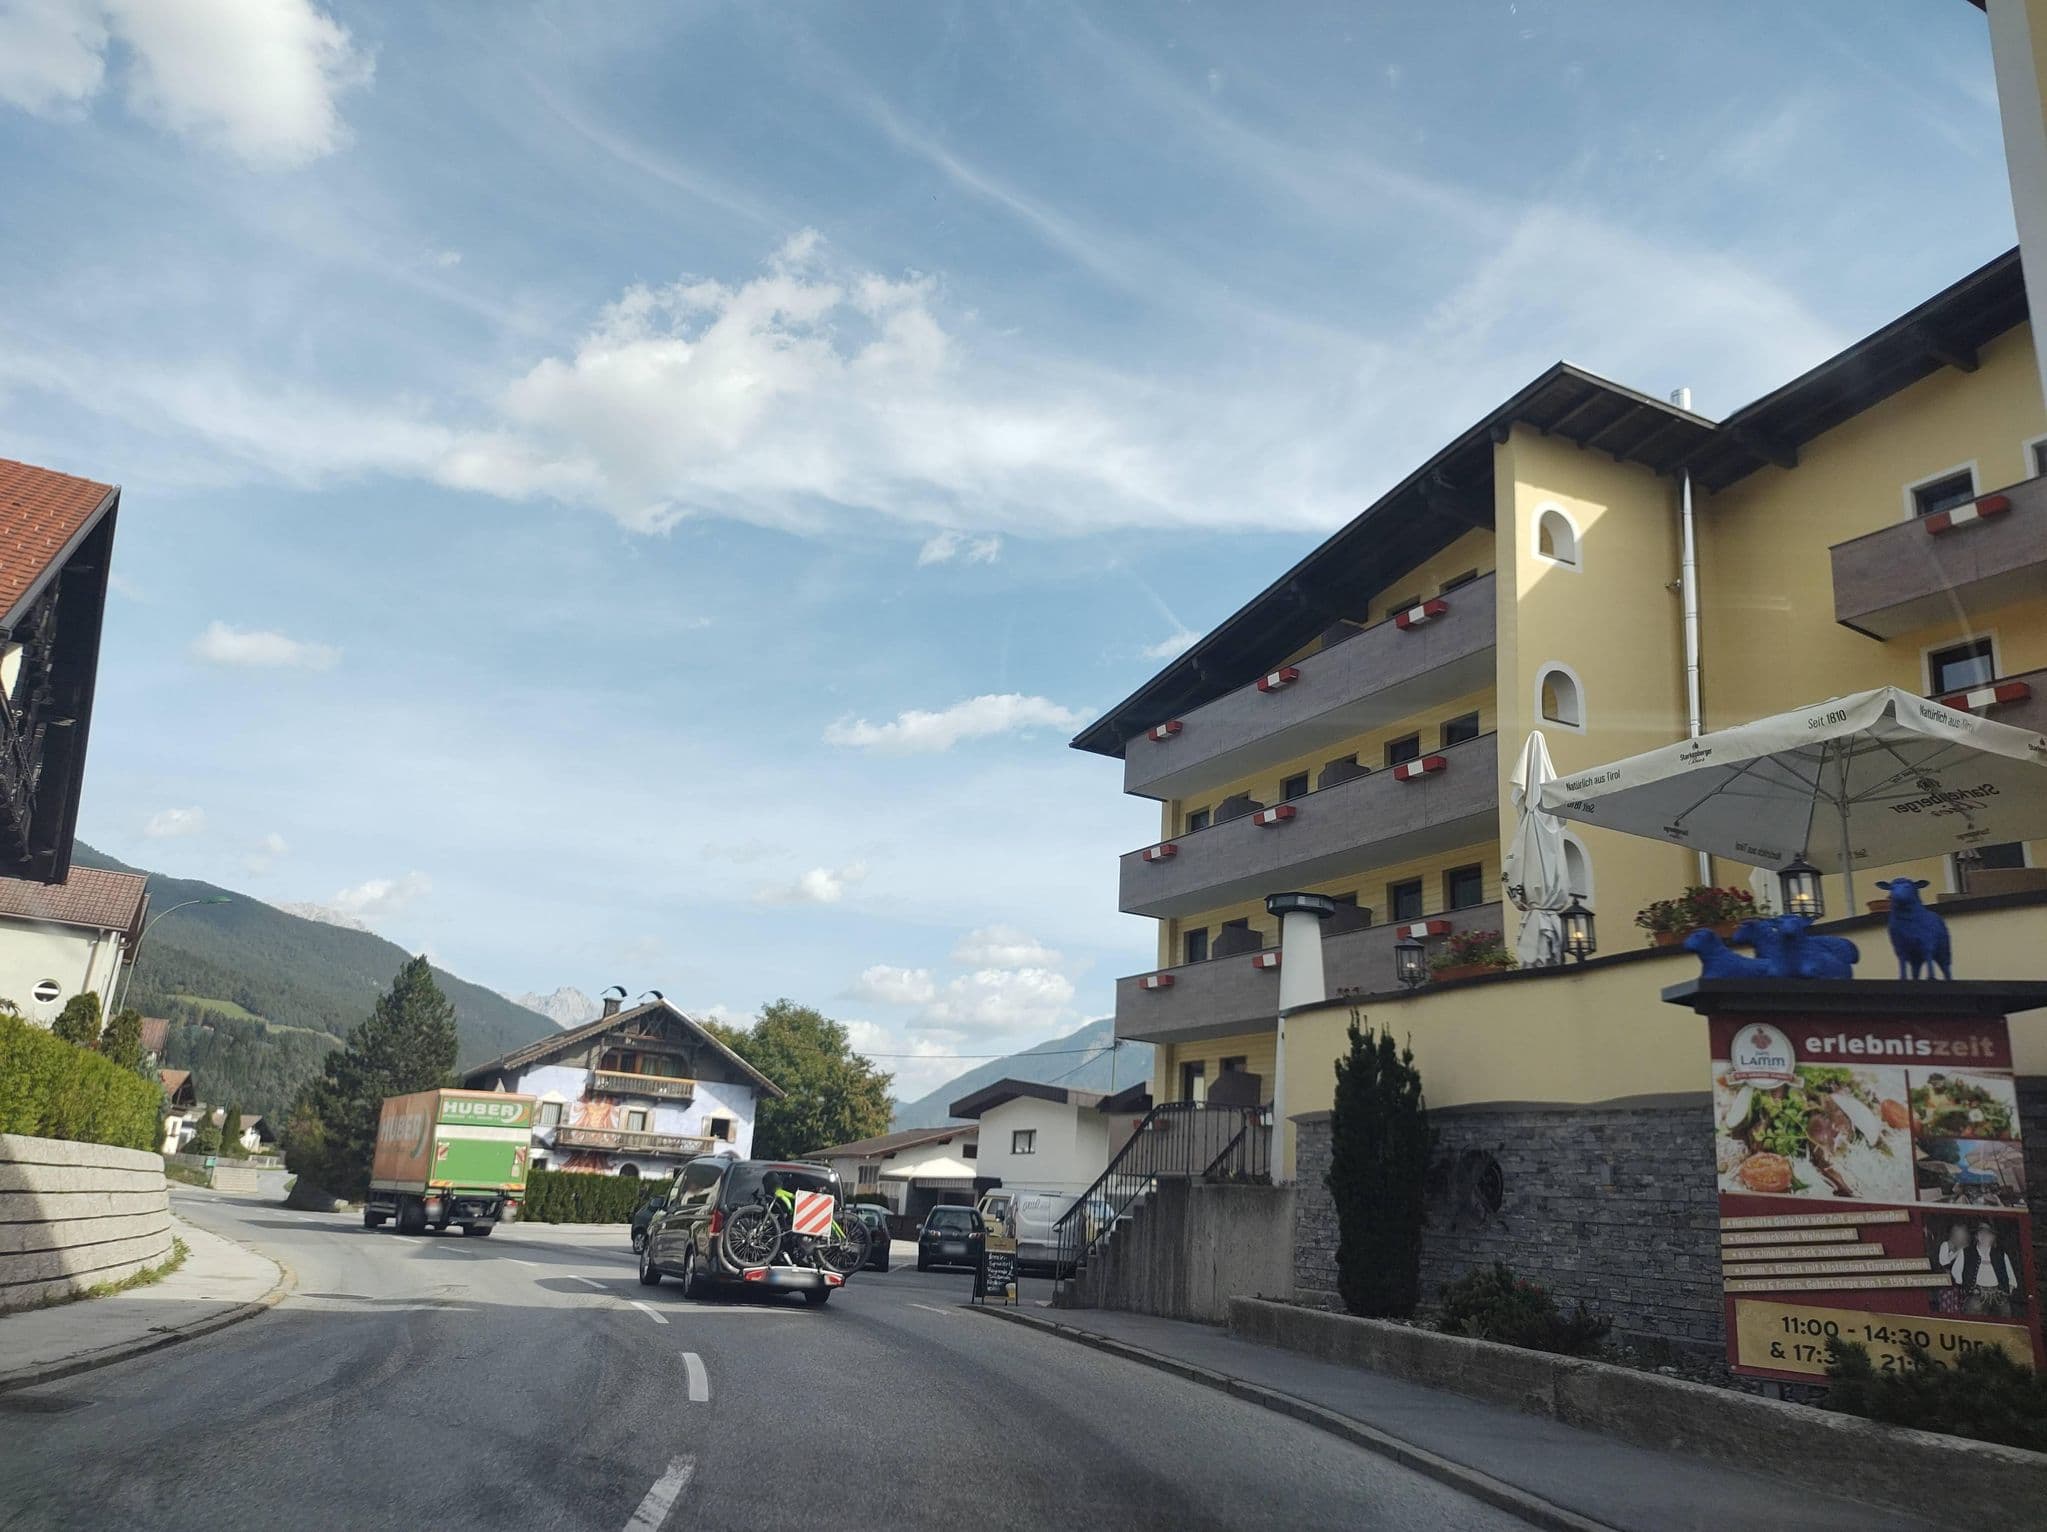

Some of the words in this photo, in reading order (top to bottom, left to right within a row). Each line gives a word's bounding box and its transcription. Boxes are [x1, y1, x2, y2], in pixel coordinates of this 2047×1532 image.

[1807, 717, 1825, 730] Seit
[1826, 709, 1847, 724] 1810
[1919, 704, 1948, 725] Natürlich
[1948, 717, 1961, 729] aus
[1566, 777, 1593, 792] Natürlich
[1594, 775, 1606, 785] aus
[1606, 769, 1621, 782] Tirol
[1804, 1032, 1995, 1058] erlebniszeit
[443, 1101, 514, 1117] HUBER
[1791, 1245, 1817, 1257] Snack
[1781, 1316, 1839, 1337] 11:00
[1864, 1324, 1931, 1349] 14:30
[1940, 1333, 1986, 1353] Uhr
[1770, 1340, 1786, 1360] &
[1793, 1343, 1841, 1366] 17:3
